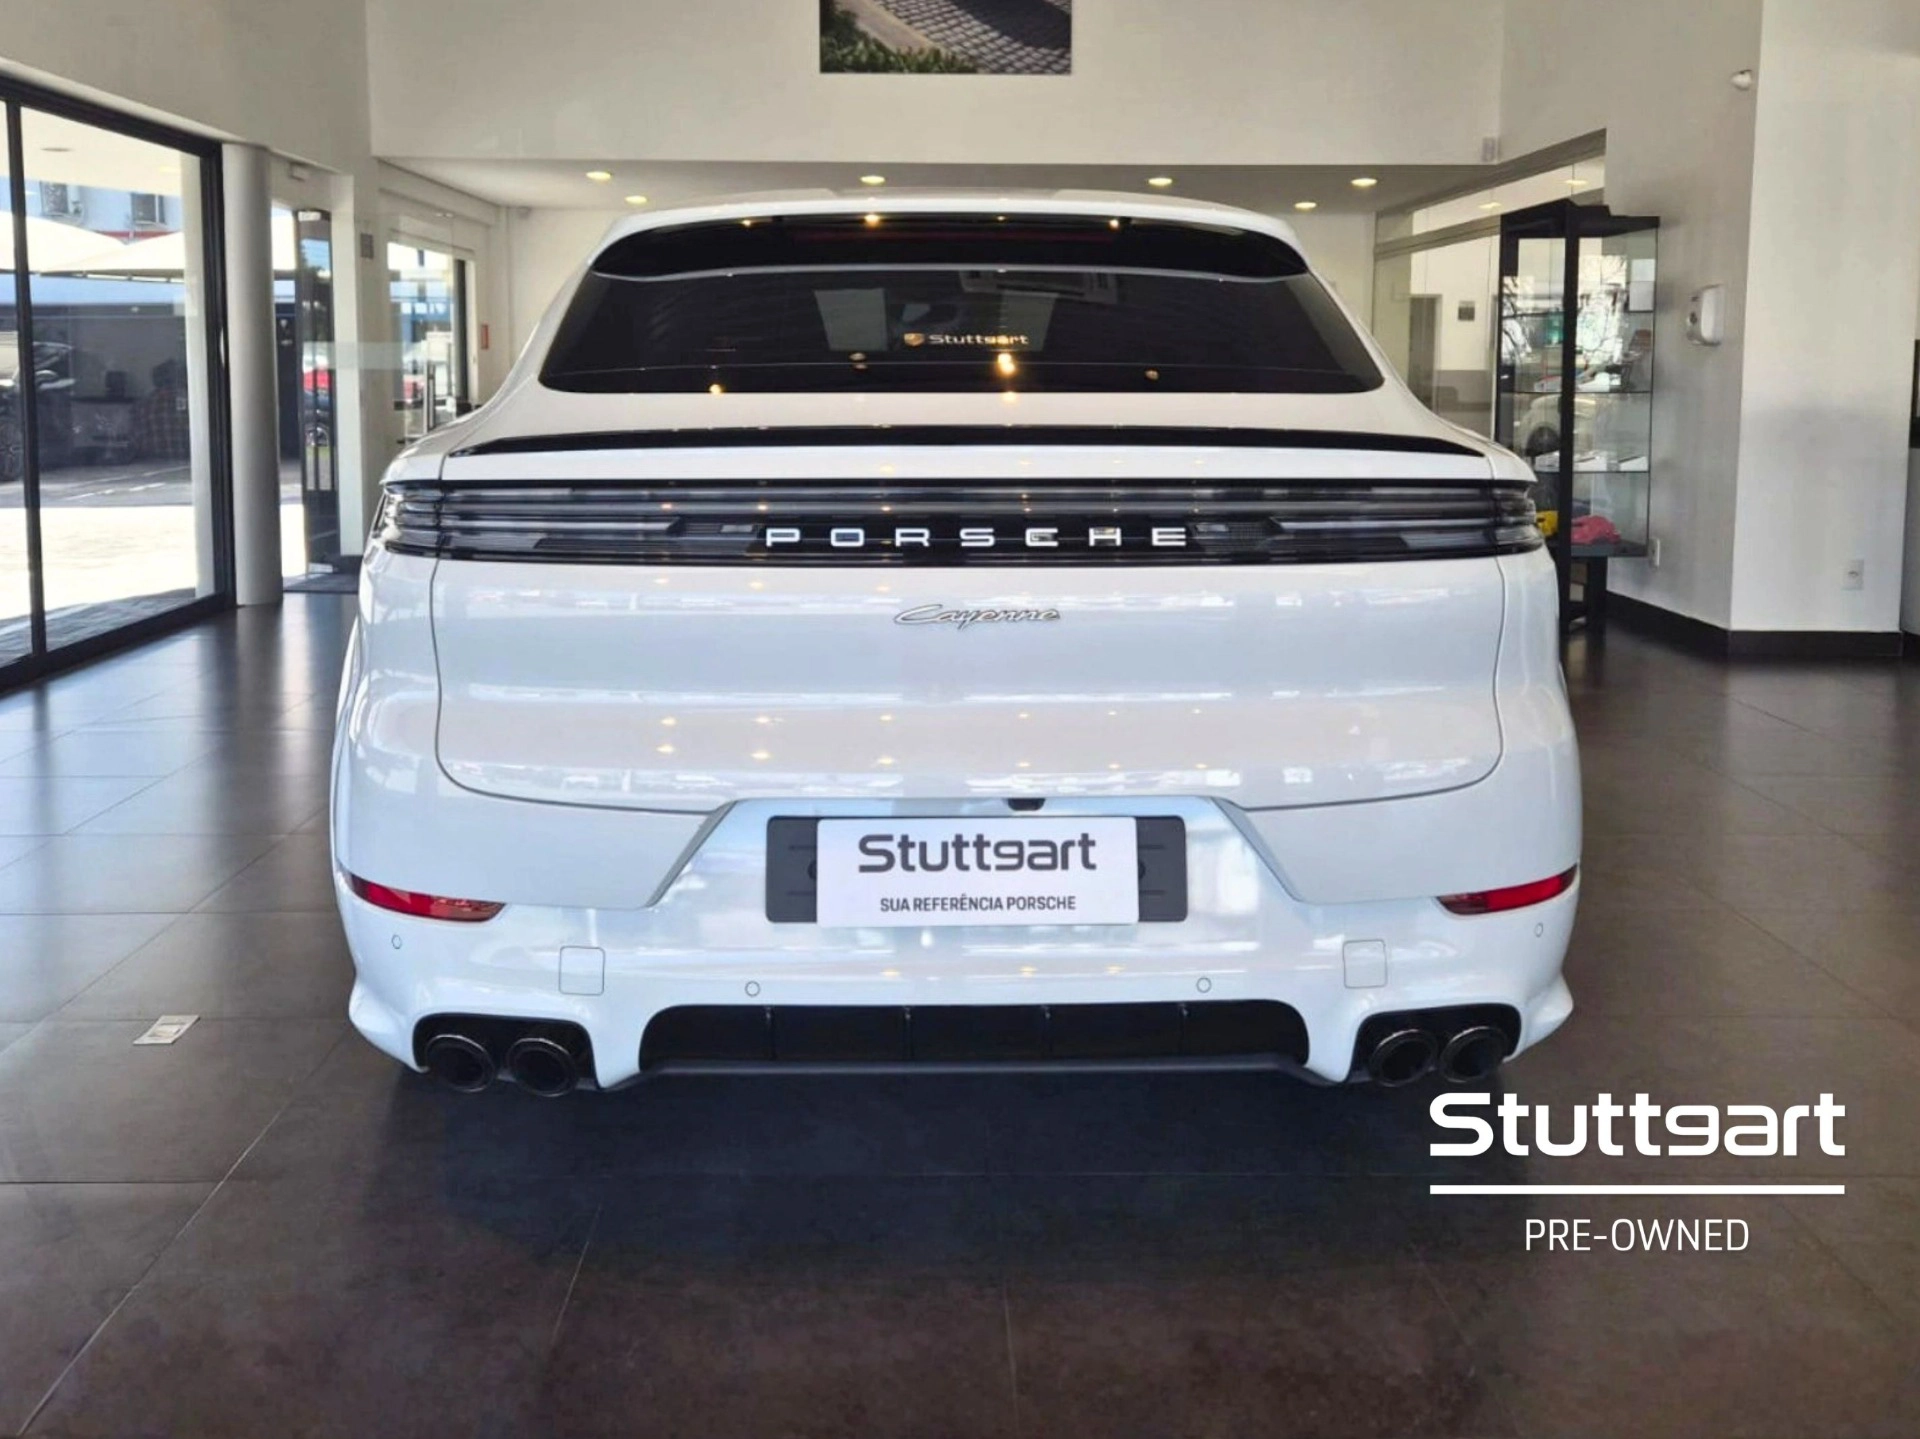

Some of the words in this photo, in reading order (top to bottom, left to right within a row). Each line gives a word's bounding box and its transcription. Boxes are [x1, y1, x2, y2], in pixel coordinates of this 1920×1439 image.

[765, 527, 1187, 547] PORSCHE
[894, 604, 1060, 629] Cayenne
[858, 833, 1097, 873] Stuttgart
[880, 897, 911, 912] SUA
[913, 893, 1004, 911] REFERÊNCIA
[1006, 896, 1076, 911] PORSCHE
